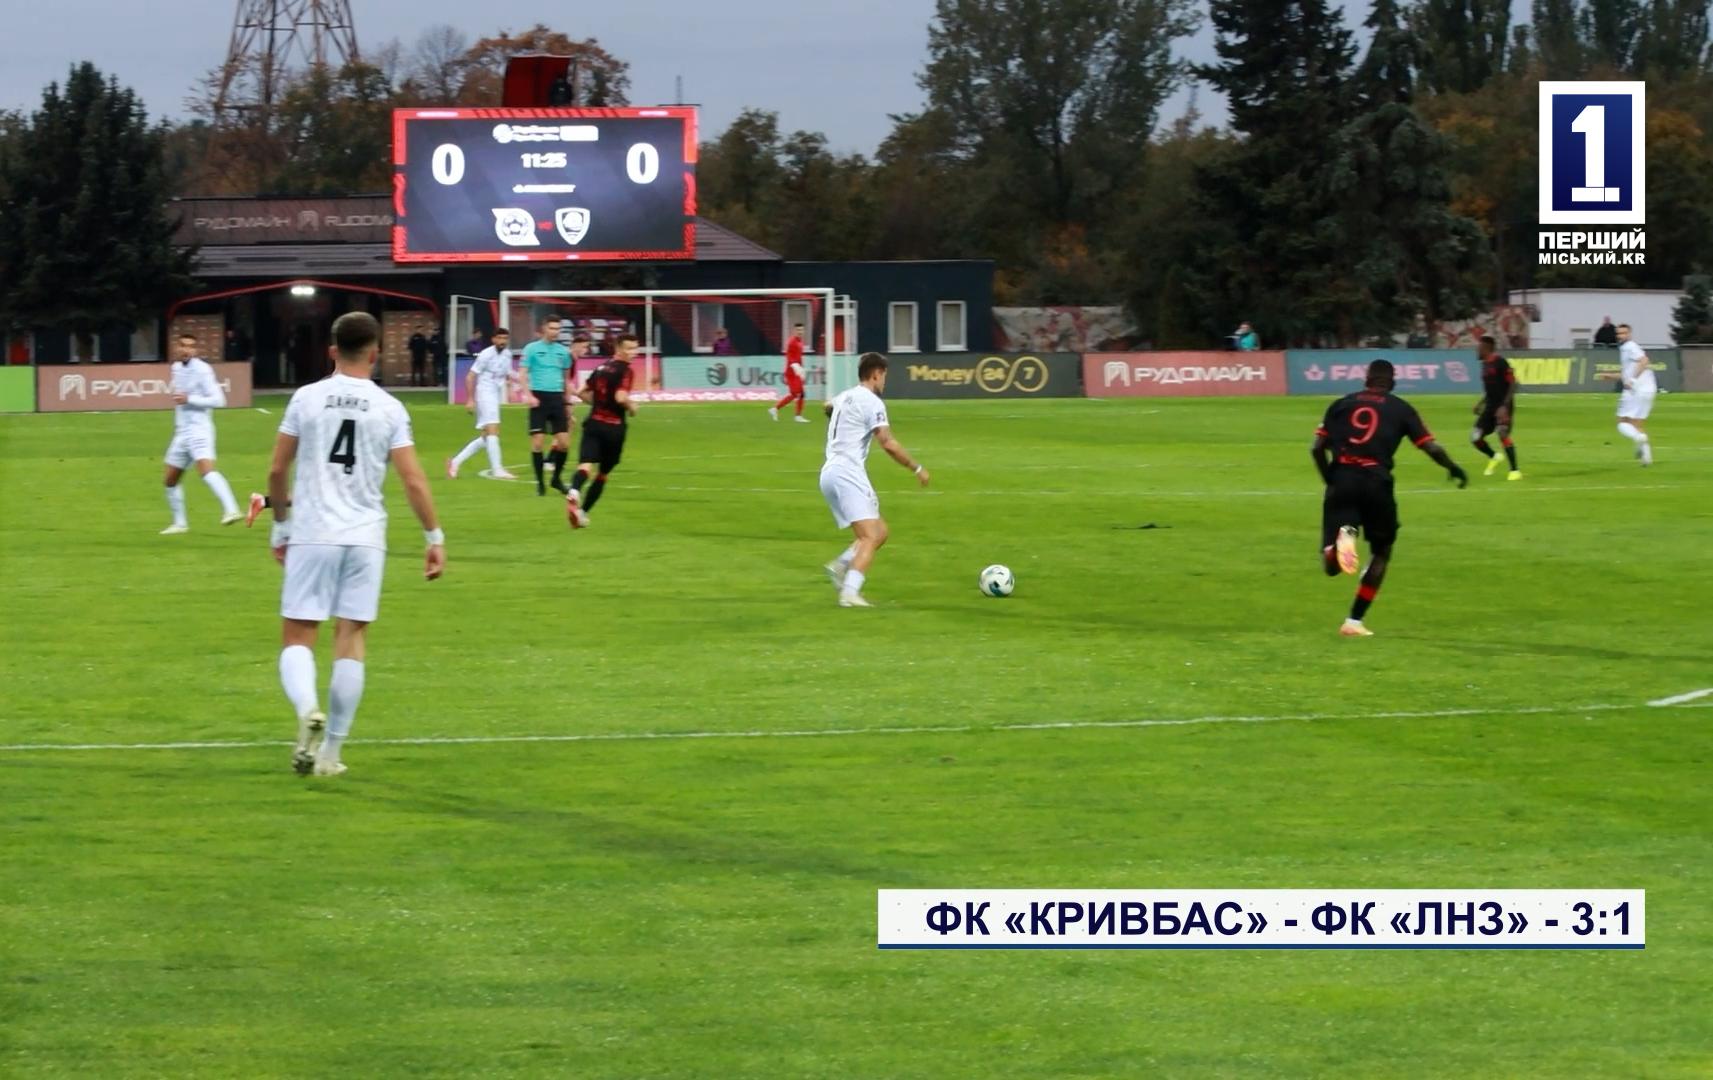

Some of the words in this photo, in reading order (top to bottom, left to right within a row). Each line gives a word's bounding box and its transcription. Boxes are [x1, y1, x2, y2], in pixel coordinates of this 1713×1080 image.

[432, 143, 465, 185] 0
[626, 143, 659, 184] 0
[737, 363, 827, 386] Ukrit
[907, 365, 976, 385] Money
[983, 367, 1006, 381] 24
[1022, 366, 1036, 380] 7
[1134, 359, 1266, 384] РУДОМАЙН
[1331, 364, 1440, 381] FABET
[91, 377, 231, 397] РУДОМН
[1349, 406, 1378, 444] 9
[328, 419, 356, 475] 4
